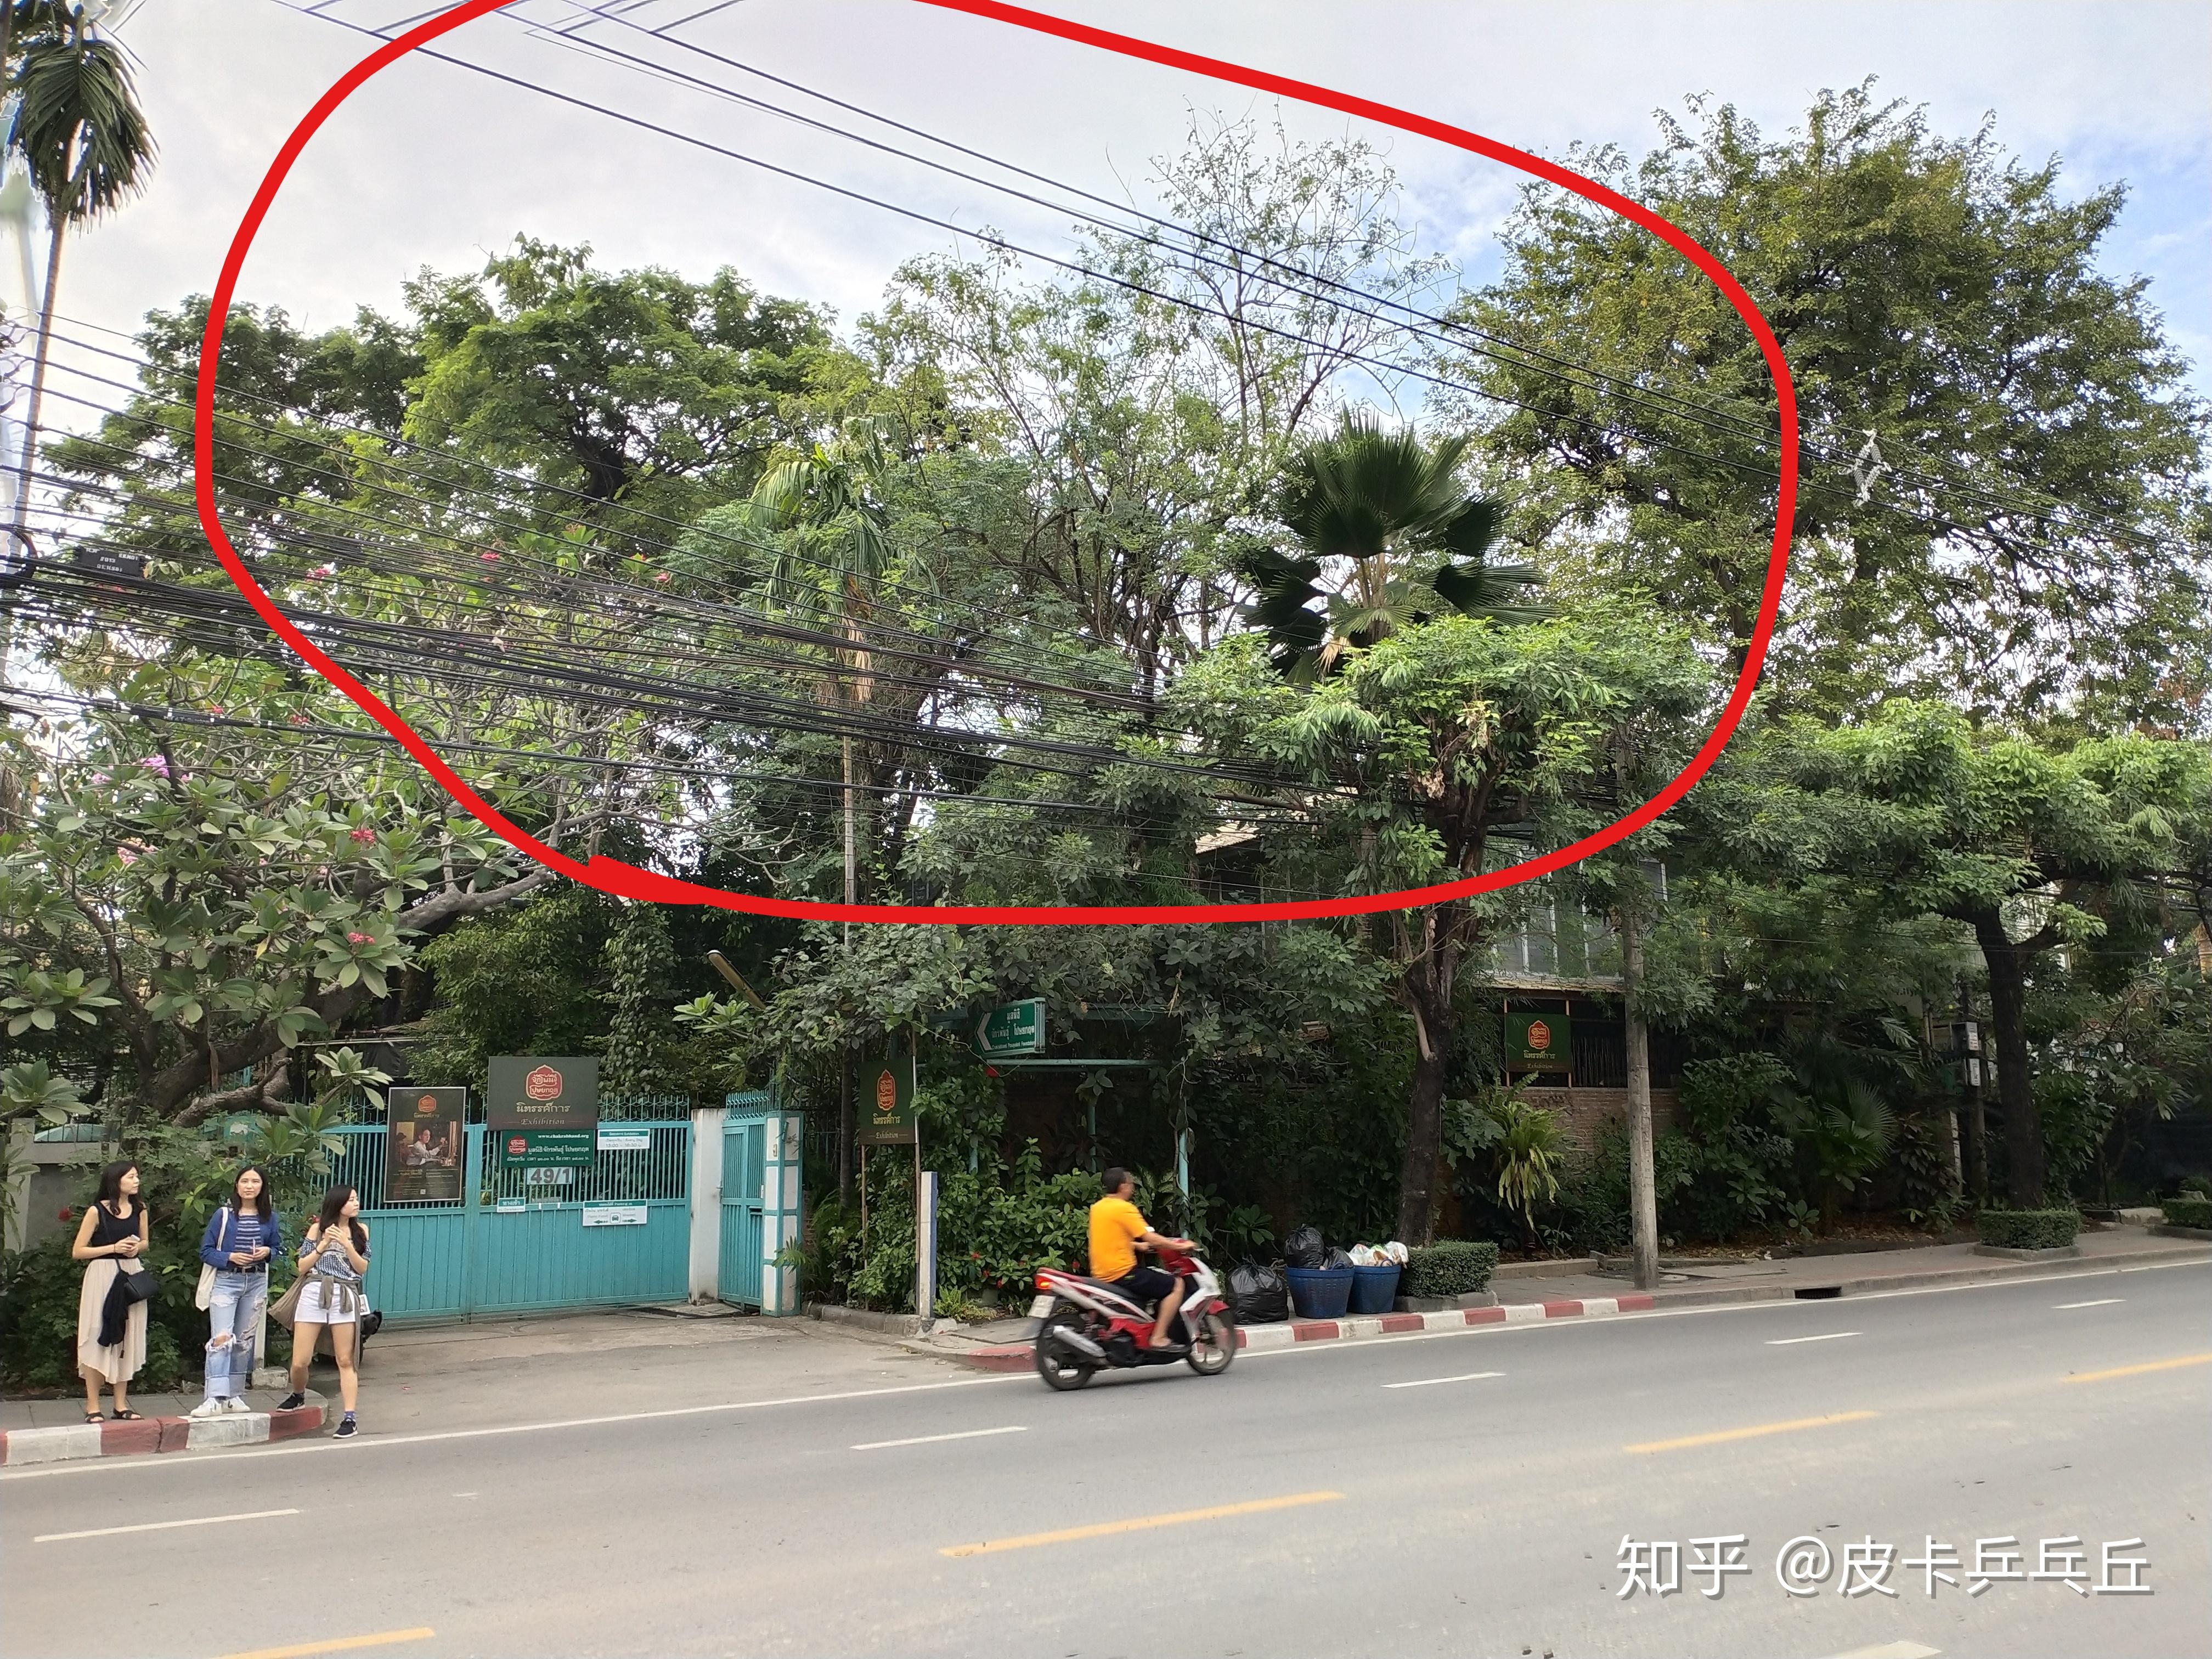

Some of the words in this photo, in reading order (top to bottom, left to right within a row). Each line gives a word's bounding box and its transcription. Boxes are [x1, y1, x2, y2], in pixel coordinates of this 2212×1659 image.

[516, 1102, 571, 1113] นิทรรศการ
[521, 1117, 565, 1125] Exhibition
[876, 1130, 899, 1139] Exhibition
[531, 1168, 570, 1183] 49/1
